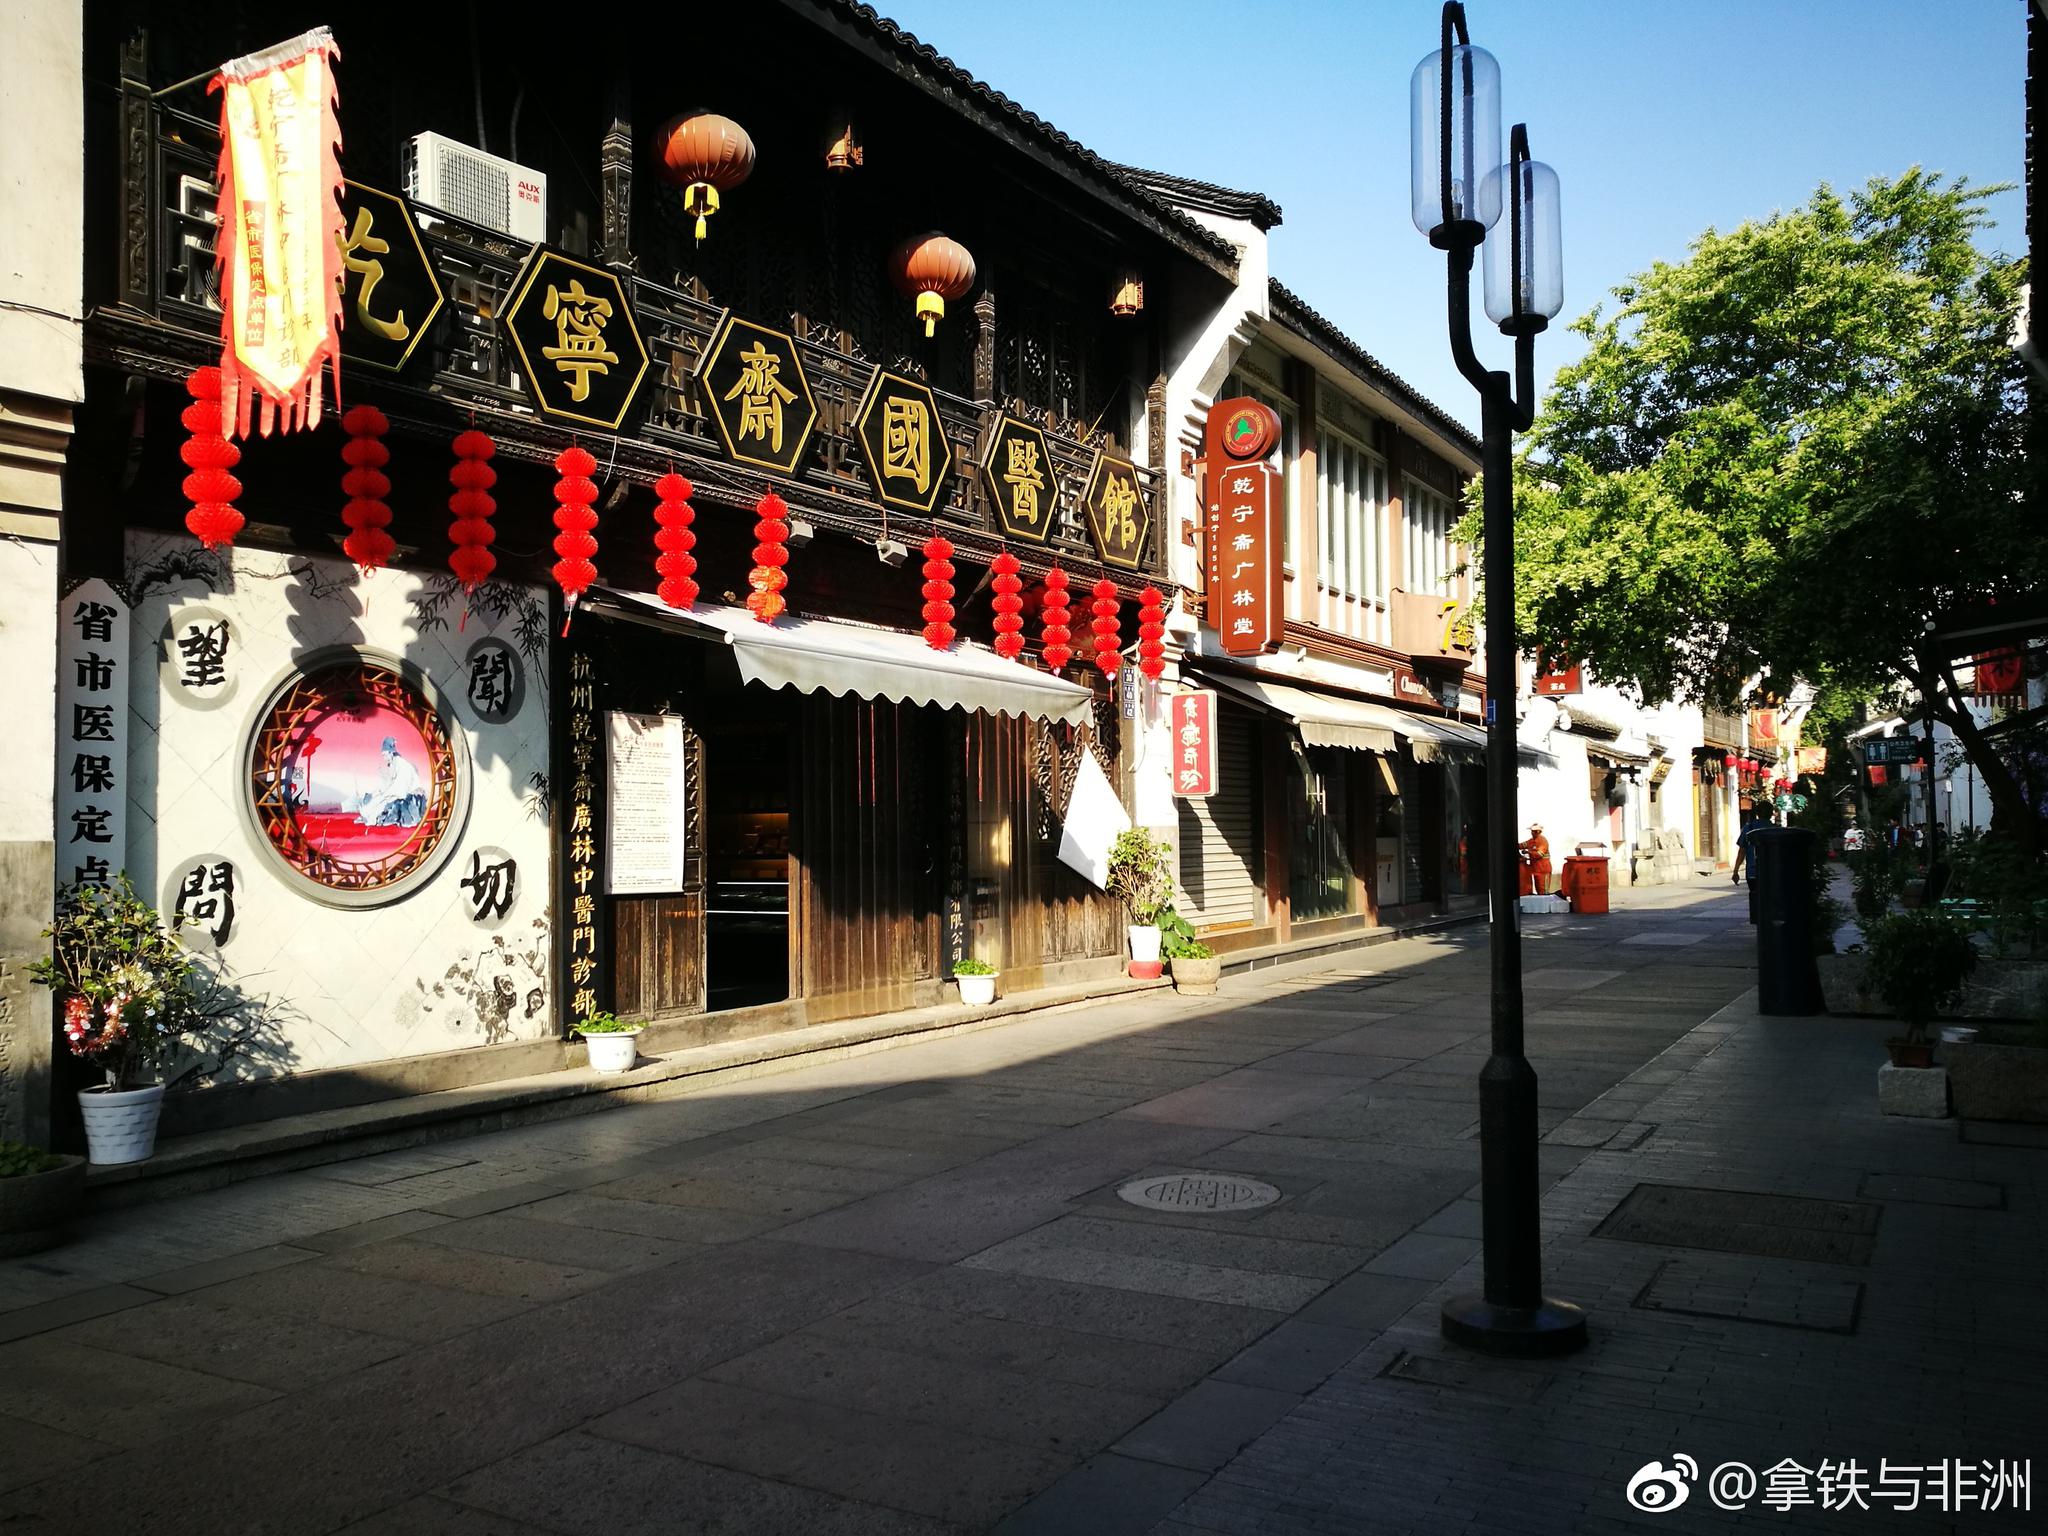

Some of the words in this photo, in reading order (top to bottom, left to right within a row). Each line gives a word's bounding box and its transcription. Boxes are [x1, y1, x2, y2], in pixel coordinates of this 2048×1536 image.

[518, 181, 540, 194] AUX
[244, 209, 265, 344] 省市医保定点单位
[1232, 476, 1255, 635] 乾宁斋广林堂
[177, 619, 230, 687] 望
[468, 650, 513, 715] 聞
[172, 862, 234, 947] 問
[460, 850, 517, 921] 切
